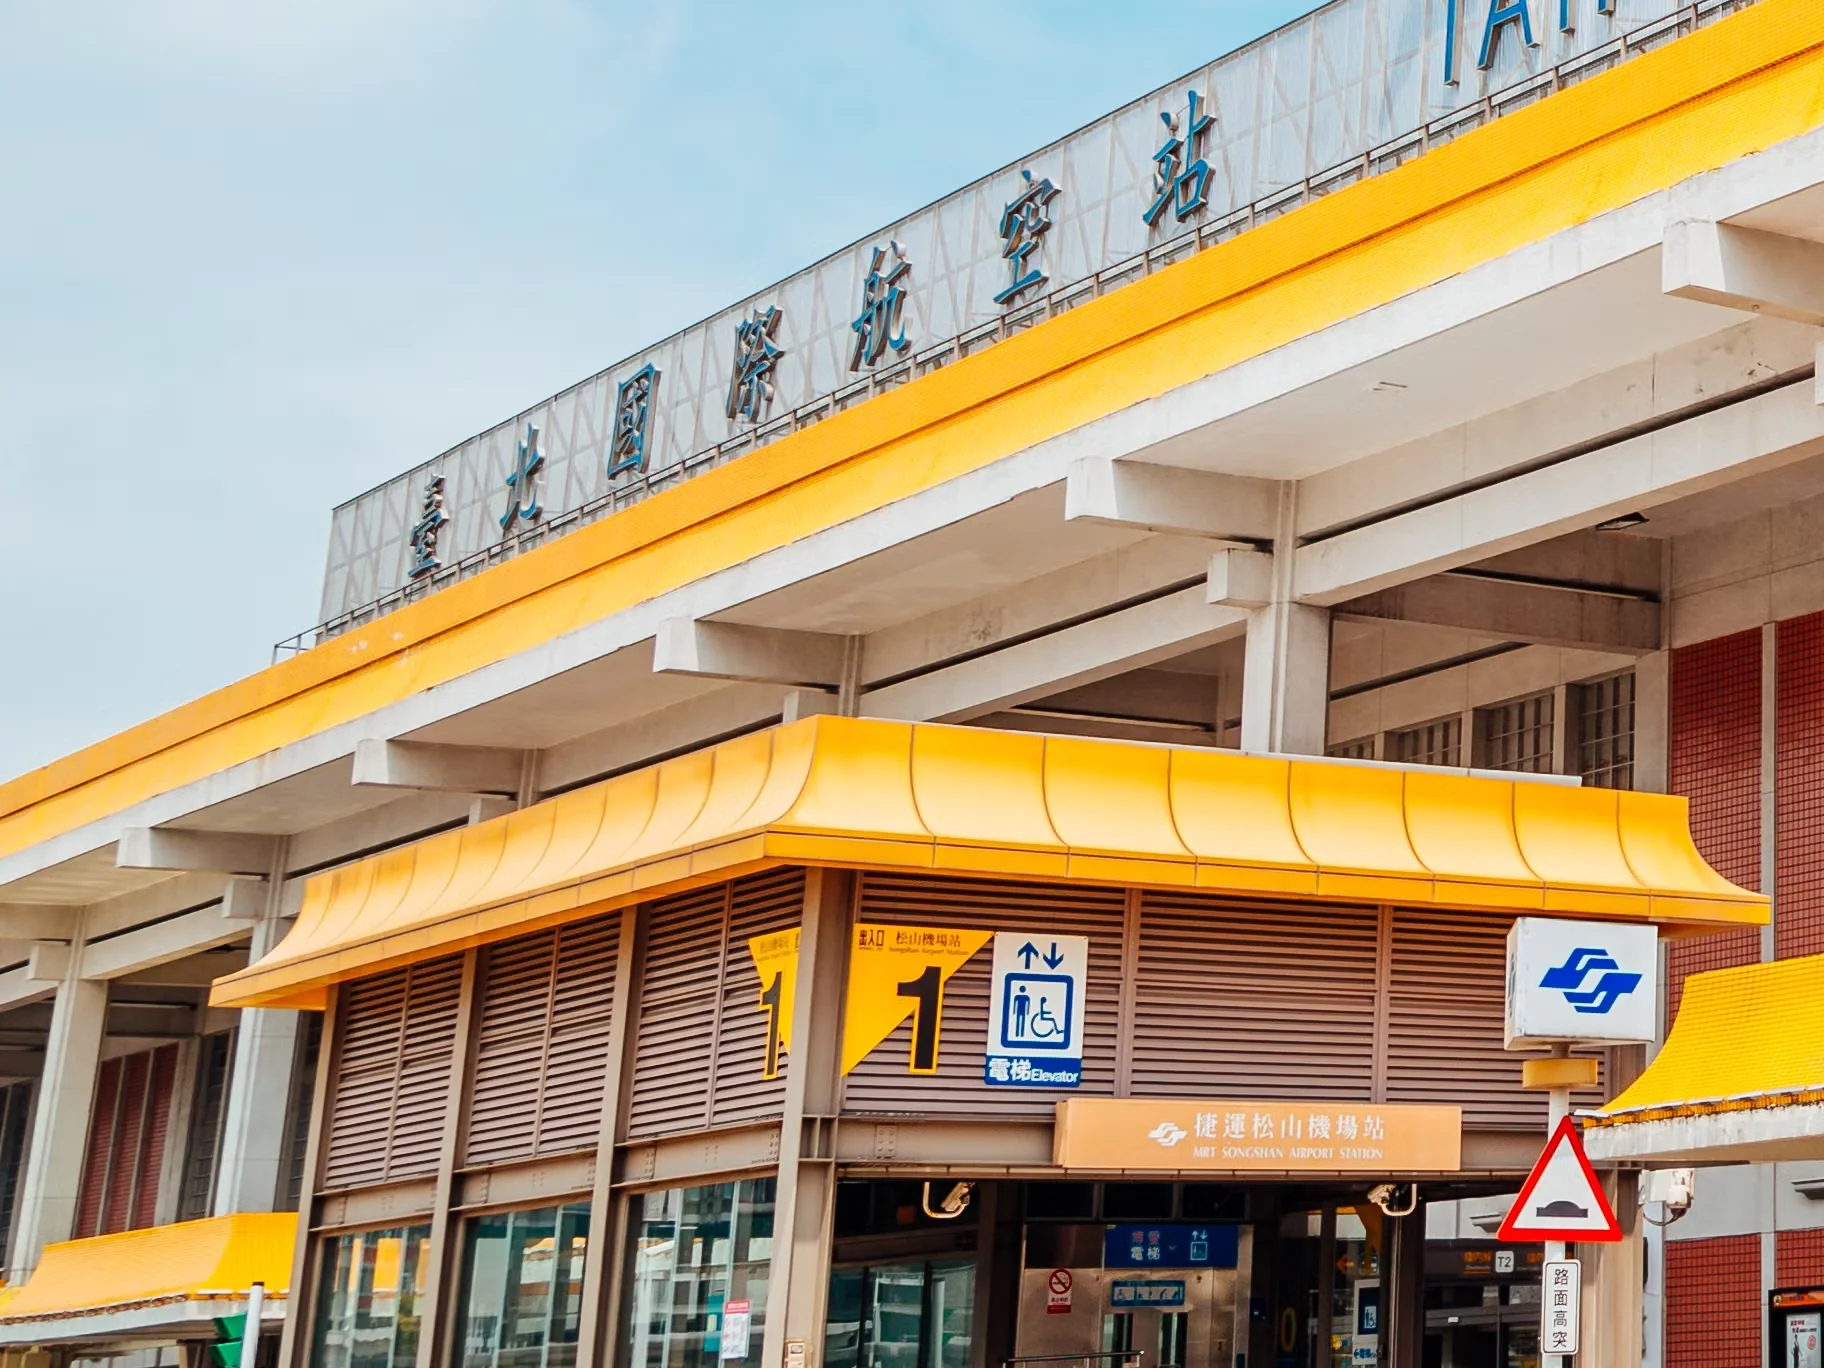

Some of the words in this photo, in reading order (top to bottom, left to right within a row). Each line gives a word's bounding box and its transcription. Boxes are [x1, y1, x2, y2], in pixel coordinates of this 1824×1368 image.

[408, 89, 1217, 579] 臺北國際航空站
[859, 929, 885, 946] 出入口
[896, 931, 961, 947] 松山機場站
[761, 971, 783, 1076] 1
[897, 965, 942, 1070] 1
[989, 1058, 1032, 1082] 電梯
[1031, 1067, 1079, 1084] Elevator
[1194, 1112, 1385, 1140] 捷運松山機場站
[1193, 1146, 1217, 1158] MRT
[1222, 1145, 1284, 1159] SONGSHAN
[1289, 1146, 1334, 1160] AIRPORT
[1339, 1147, 1384, 1160] STATION
[1497, 1256, 1512, 1269] T2
[1552, 1268, 1569, 1349] 路面高突
